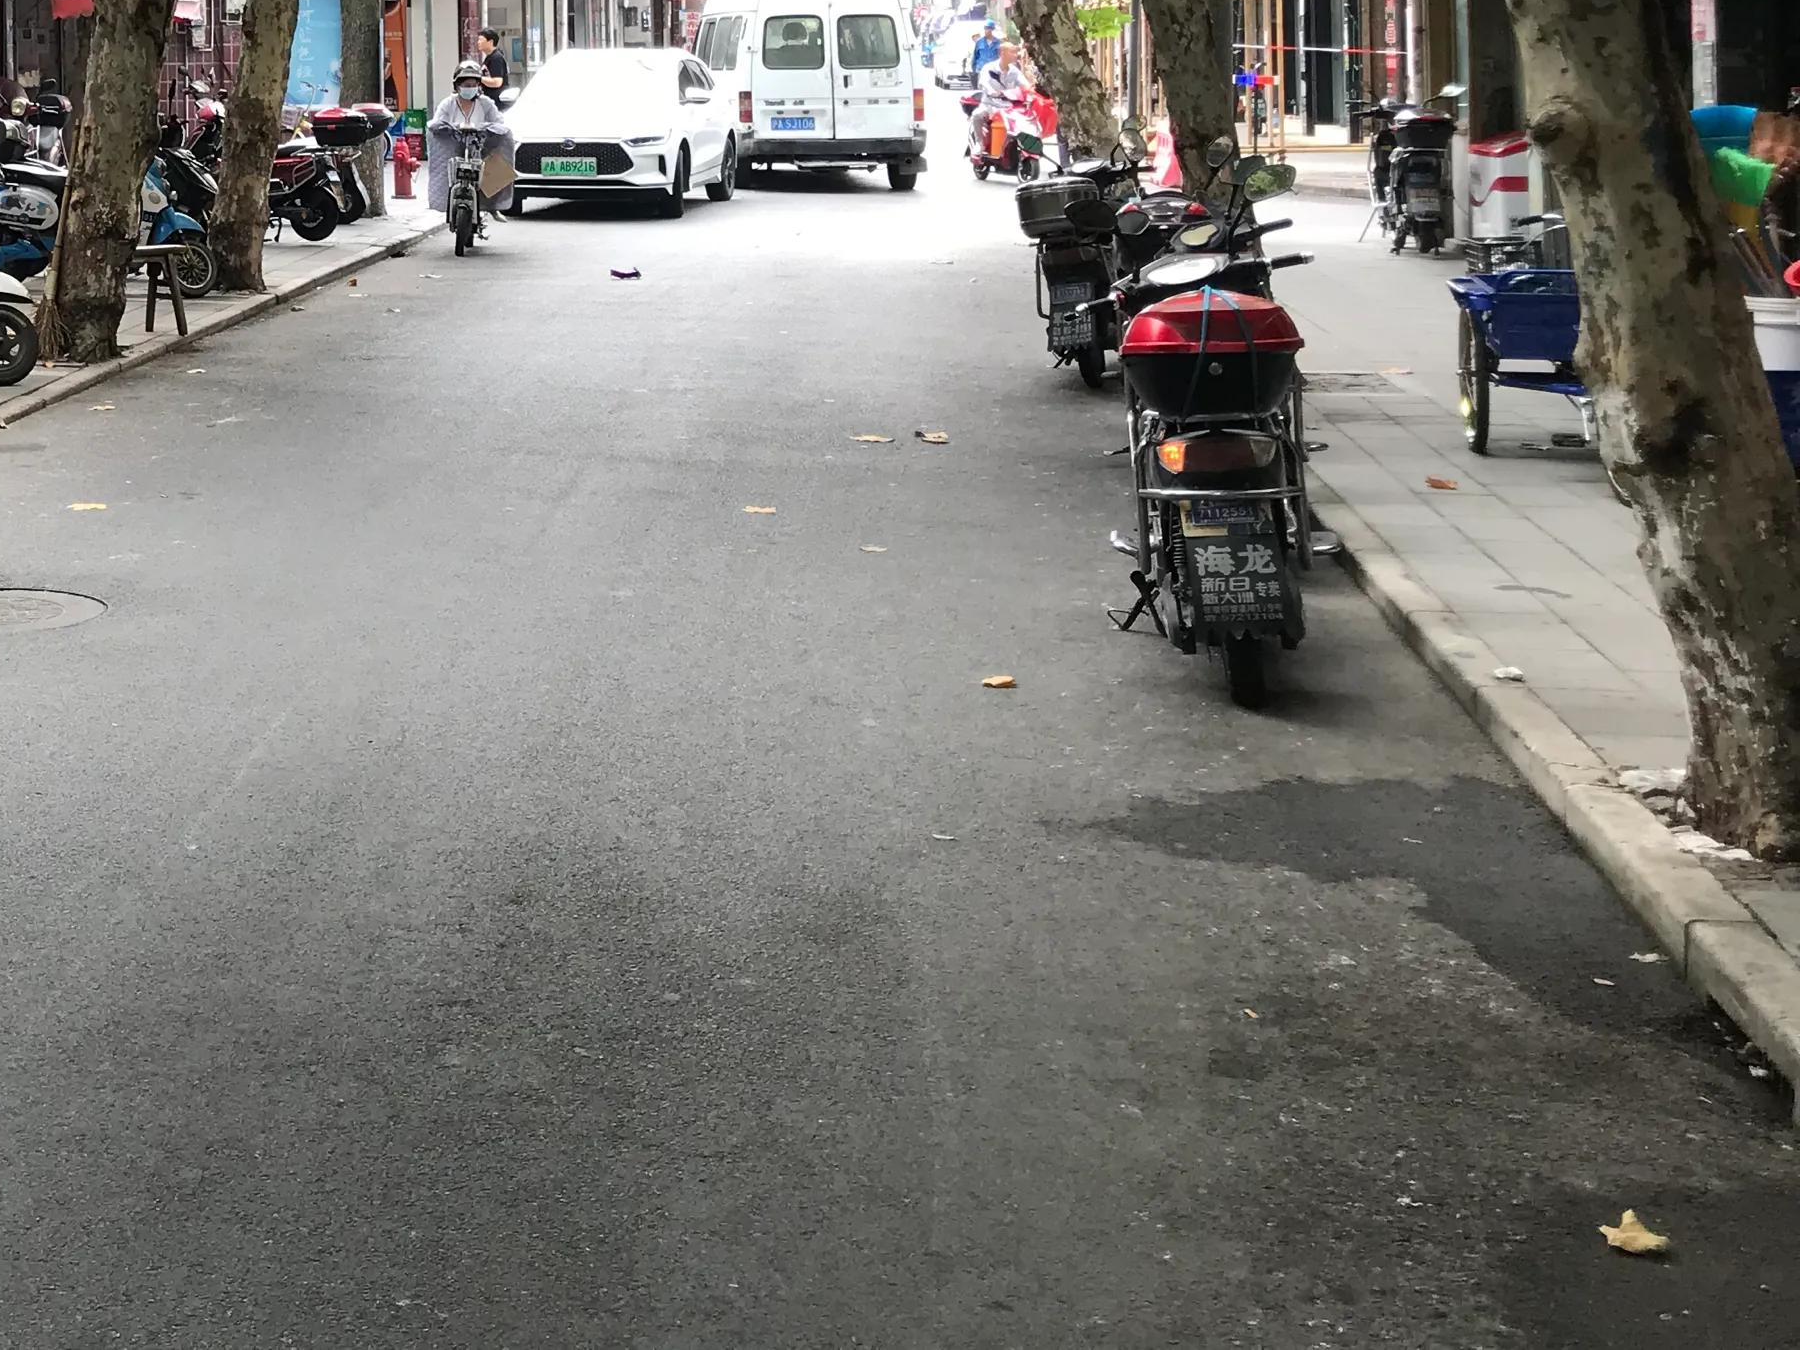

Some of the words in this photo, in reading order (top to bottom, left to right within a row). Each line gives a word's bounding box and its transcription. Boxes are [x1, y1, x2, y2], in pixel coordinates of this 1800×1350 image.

[1194, 544, 1277, 576] 海龙
[1201, 577, 1250, 592] 新日
[1255, 581, 1280, 597] 专卖
